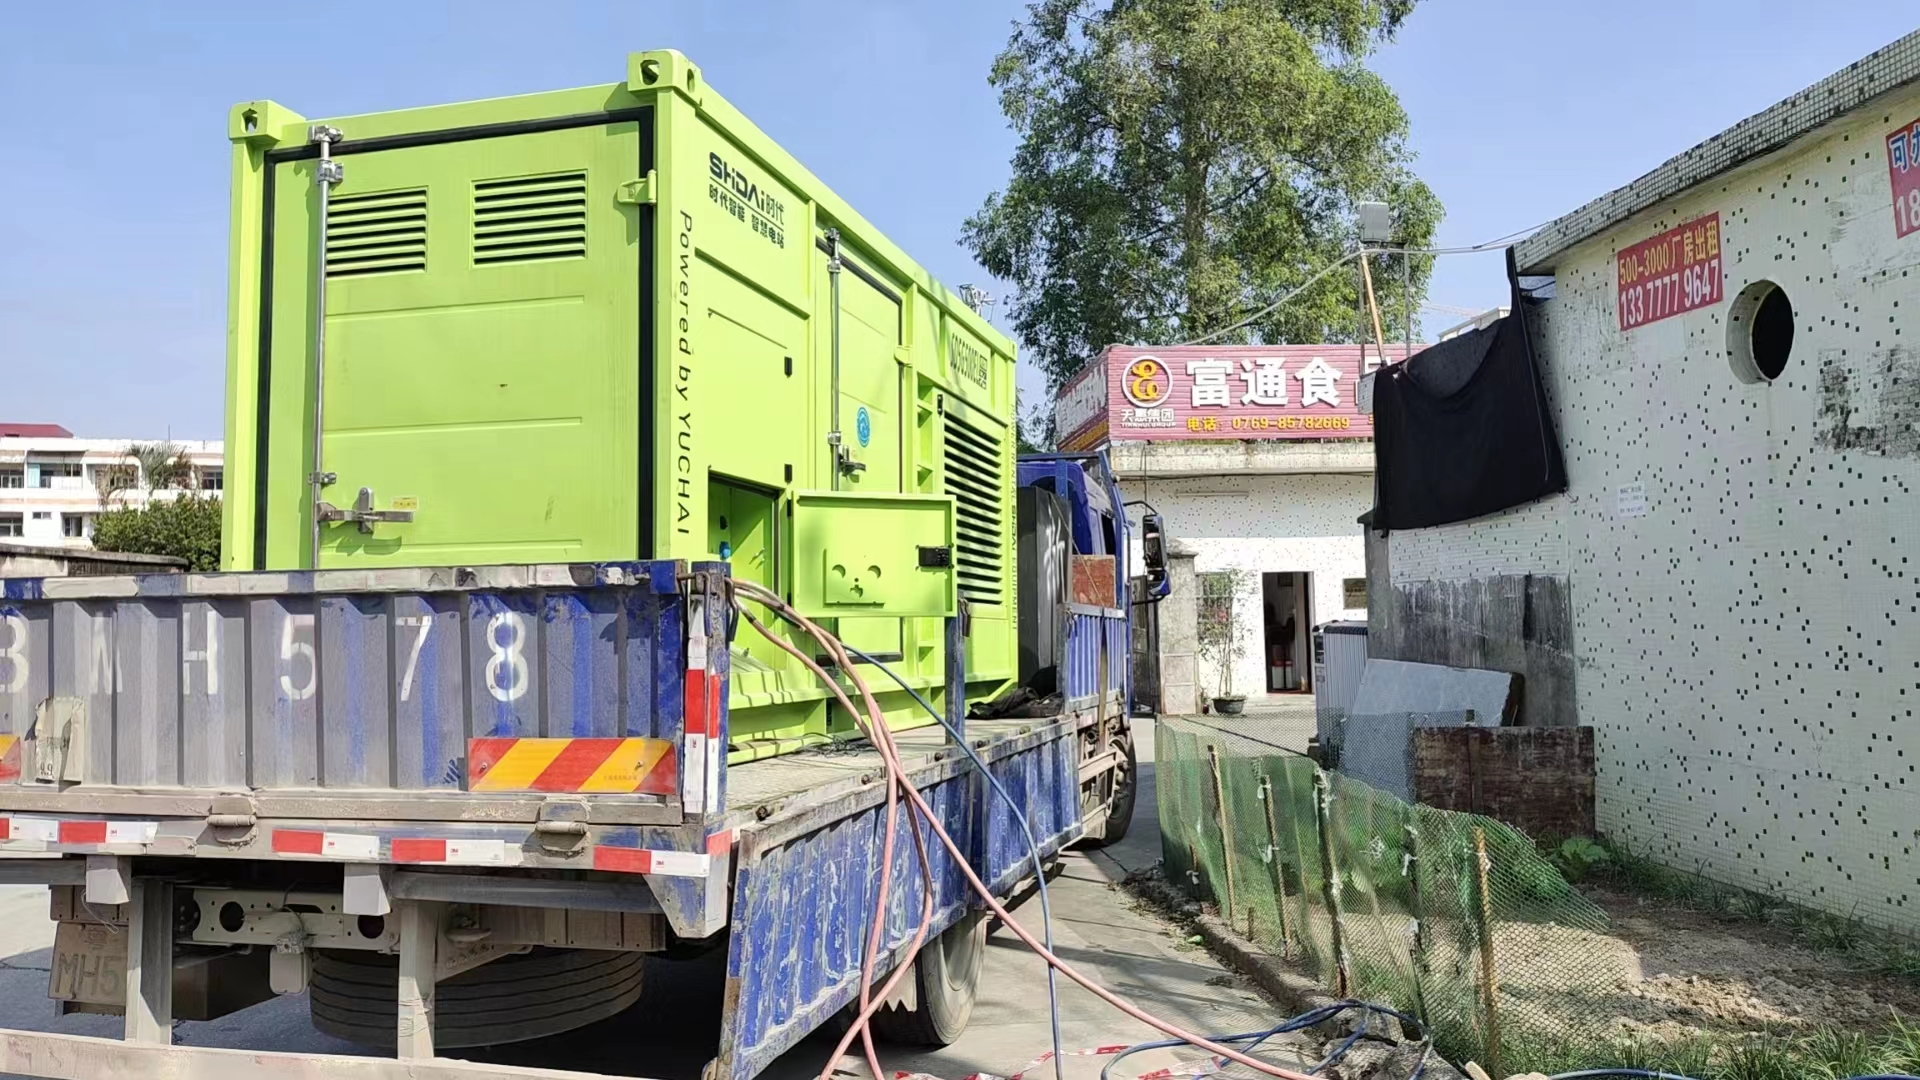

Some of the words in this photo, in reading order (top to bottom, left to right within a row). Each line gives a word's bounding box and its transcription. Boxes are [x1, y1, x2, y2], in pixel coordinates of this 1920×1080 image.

[766, 194, 784, 226] 时代
[679, 210, 692, 355] Powered
[1620, 221, 1719, 285] 500-3000厂房出租
[1621, 285, 1644, 327] 133
[1646, 273, 1679, 319] 7777
[1684, 259, 1719, 308] 9647
[676, 365, 691, 401] by
[1231, 416, 1350, 430] 0769-85782669
[677, 412, 691, 534] YUCHAI
